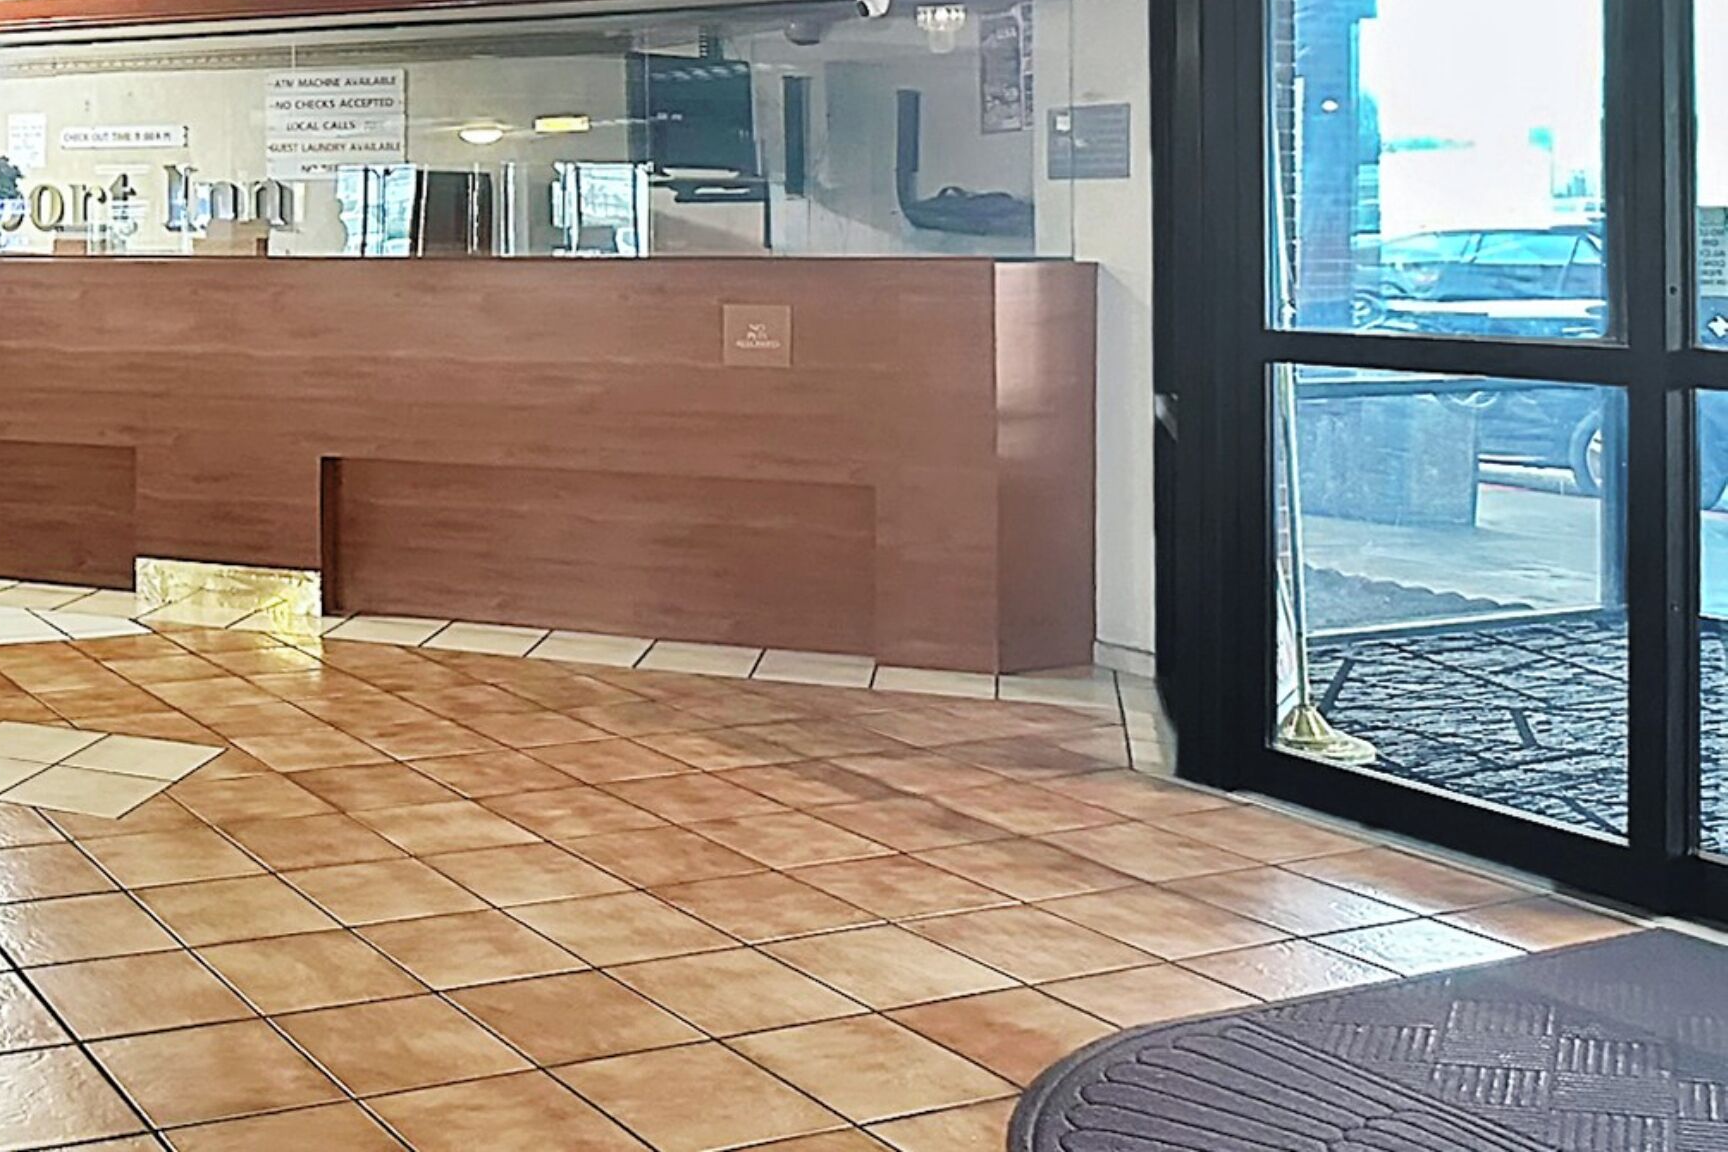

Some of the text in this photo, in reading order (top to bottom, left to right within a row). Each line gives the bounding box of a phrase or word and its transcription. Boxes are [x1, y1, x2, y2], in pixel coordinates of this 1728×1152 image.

[274, 76, 397, 88] ATM MACHINE AVAILABLE
[275, 98, 394, 110] NO CHECKS ACCEPTED
[286, 121, 319, 131] LOCAL
[322, 120, 356, 130] CALLS
[63, 133, 89, 142] CHECK
[271, 141, 400, 153] GUEST LAUNDRY AVAILABLE
[164, 164, 294, 232] Inn
